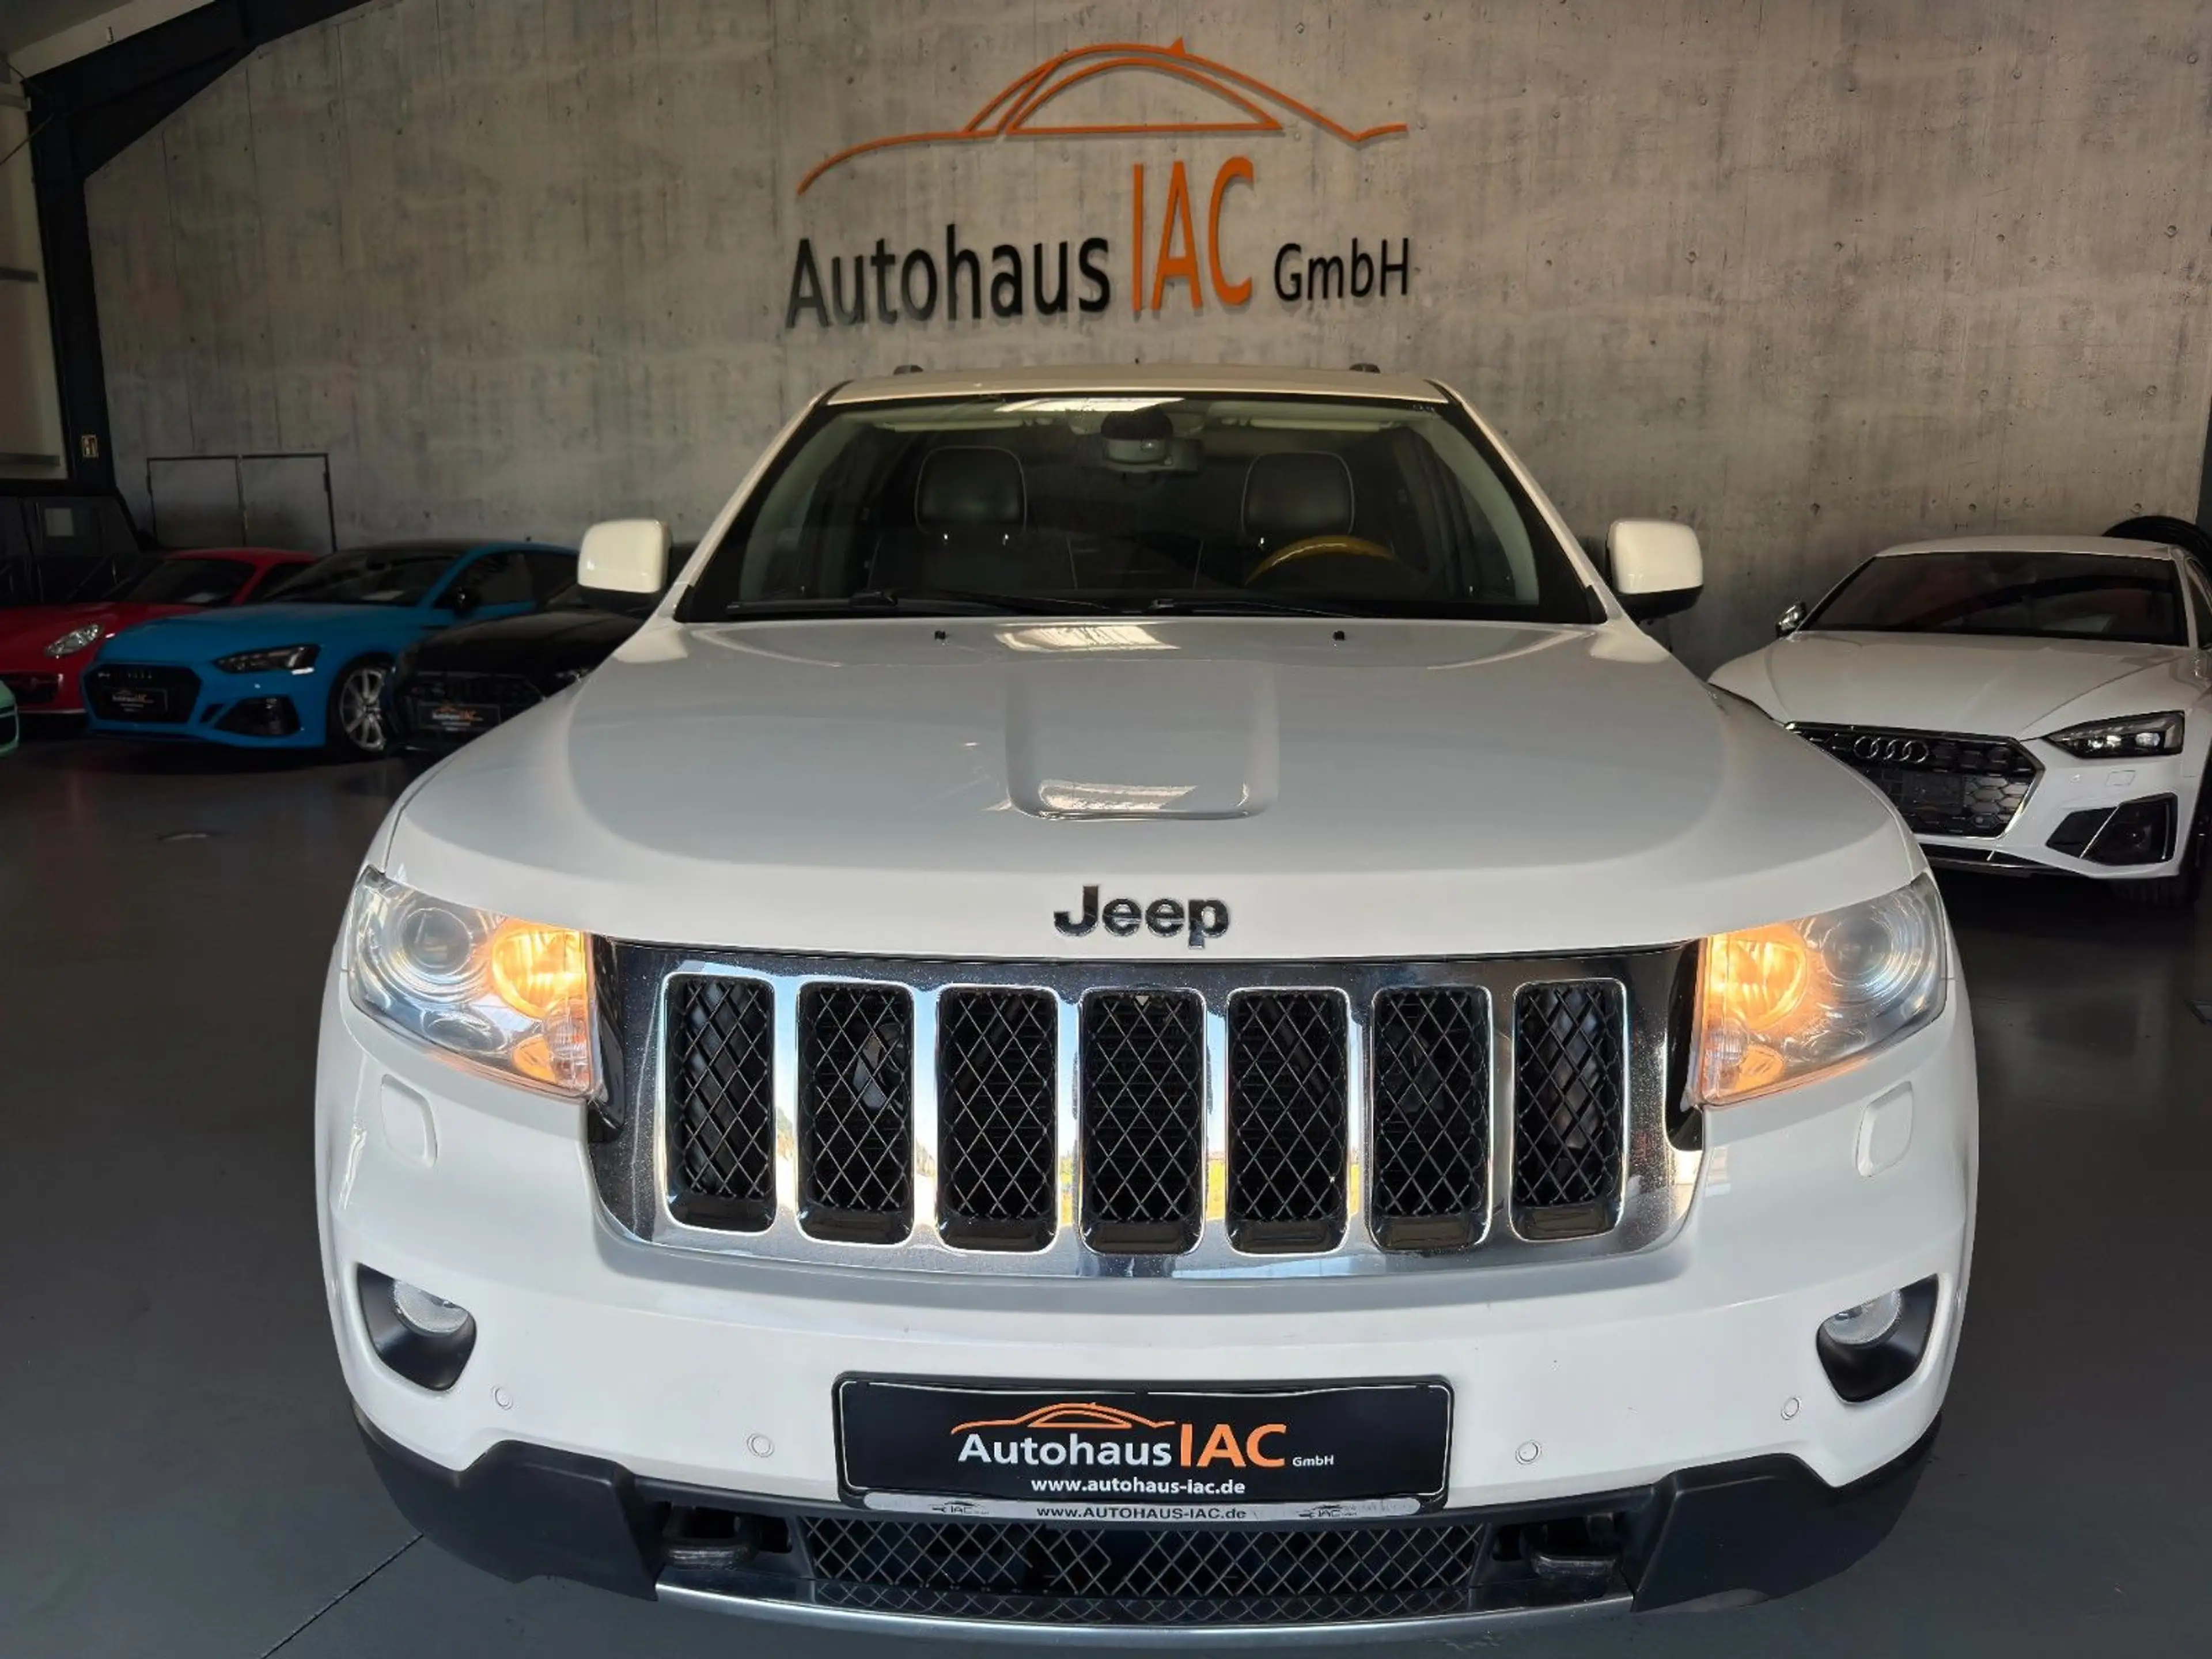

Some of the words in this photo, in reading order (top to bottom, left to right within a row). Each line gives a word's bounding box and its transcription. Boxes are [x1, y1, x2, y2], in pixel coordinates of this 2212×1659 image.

[786, 224, 1110, 328] Autohaus
[1132, 156, 1253, 312] IAC
[1274, 237, 1409, 301] GmbH
[1054, 885, 1229, 950] Jeep
[958, 1433, 1172, 1467] Autohaus
[1180, 1423, 1287, 1468] IAC
[1292, 1455, 1335, 1467] GmbH
[1031, 1477, 1246, 1494] www.autohaus-iac.de
[1036, 1506, 1247, 1520] www.AUTOHAUS-IAC.de
